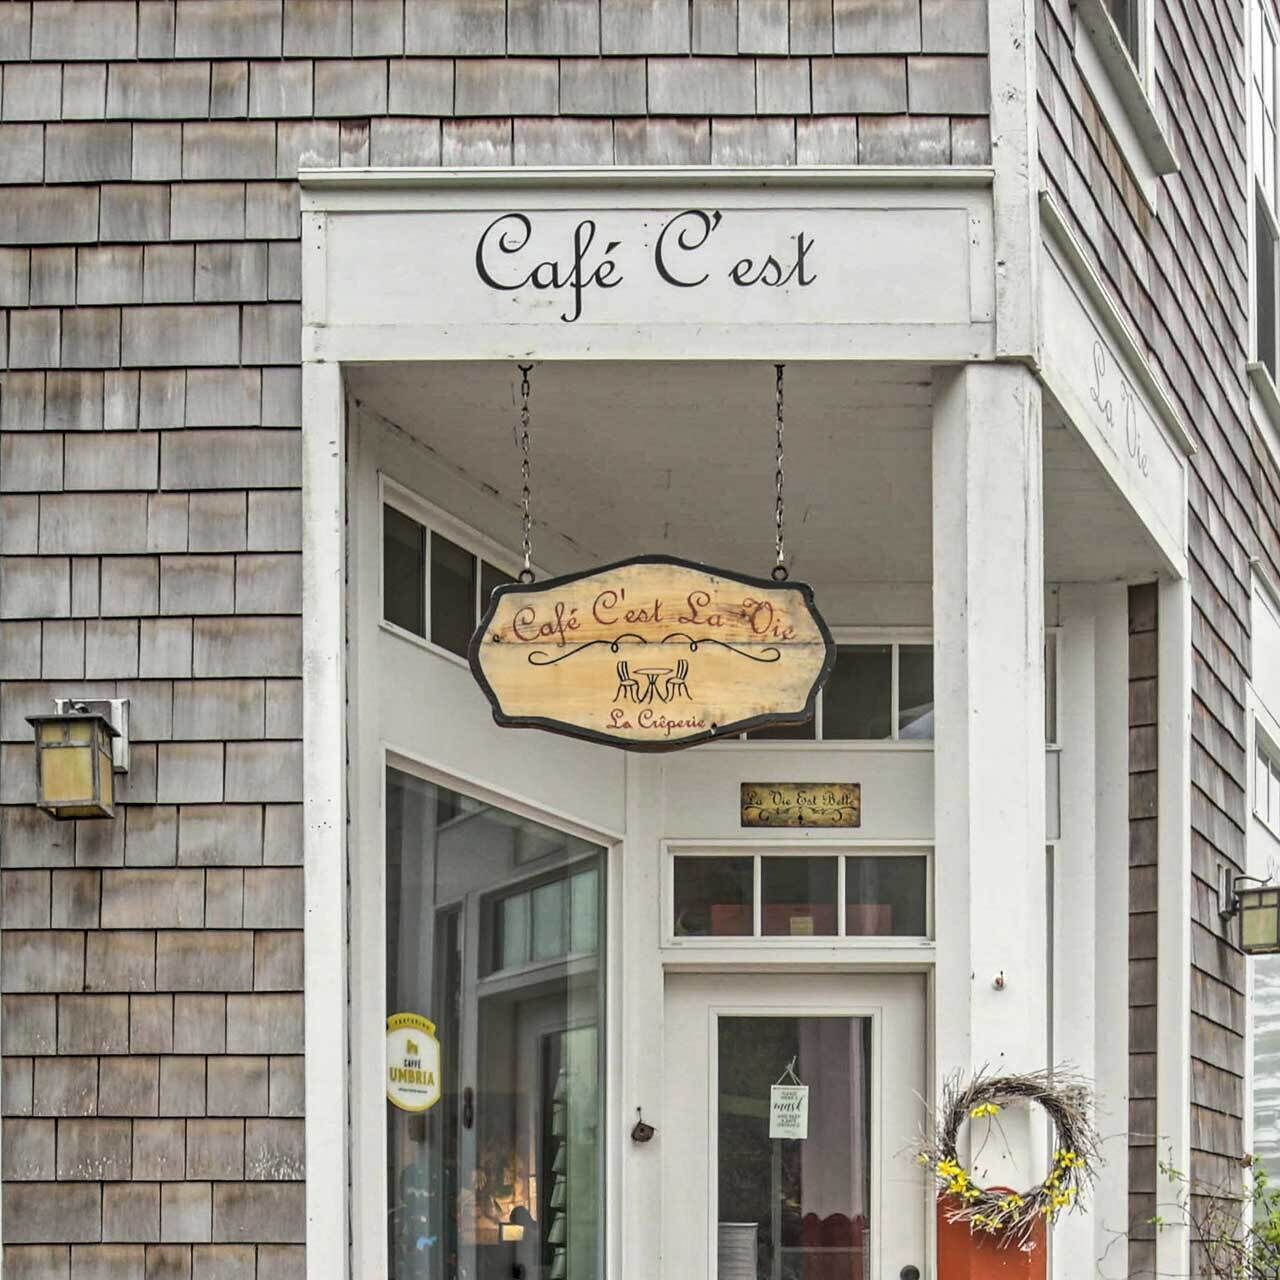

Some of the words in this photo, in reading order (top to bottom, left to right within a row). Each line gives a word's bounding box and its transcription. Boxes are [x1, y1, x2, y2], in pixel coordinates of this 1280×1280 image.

[475, 213, 624, 323] Café
[1090, 340, 1114, 428] La
[1120, 379, 1149, 479] Vie
[512, 600, 581, 648] Café
[592, 587, 663, 626] C'est
[677, 590, 724, 629] La
[742, 597, 798, 641] Vie
[606, 708, 633, 730] La
[638, 707, 706, 736] Crêperie
[746, 789, 763, 806] La
[769, 789, 791, 806] Vie
[796, 790, 817, 806] Est
[389, 1066, 435, 1086] UMBRIA
